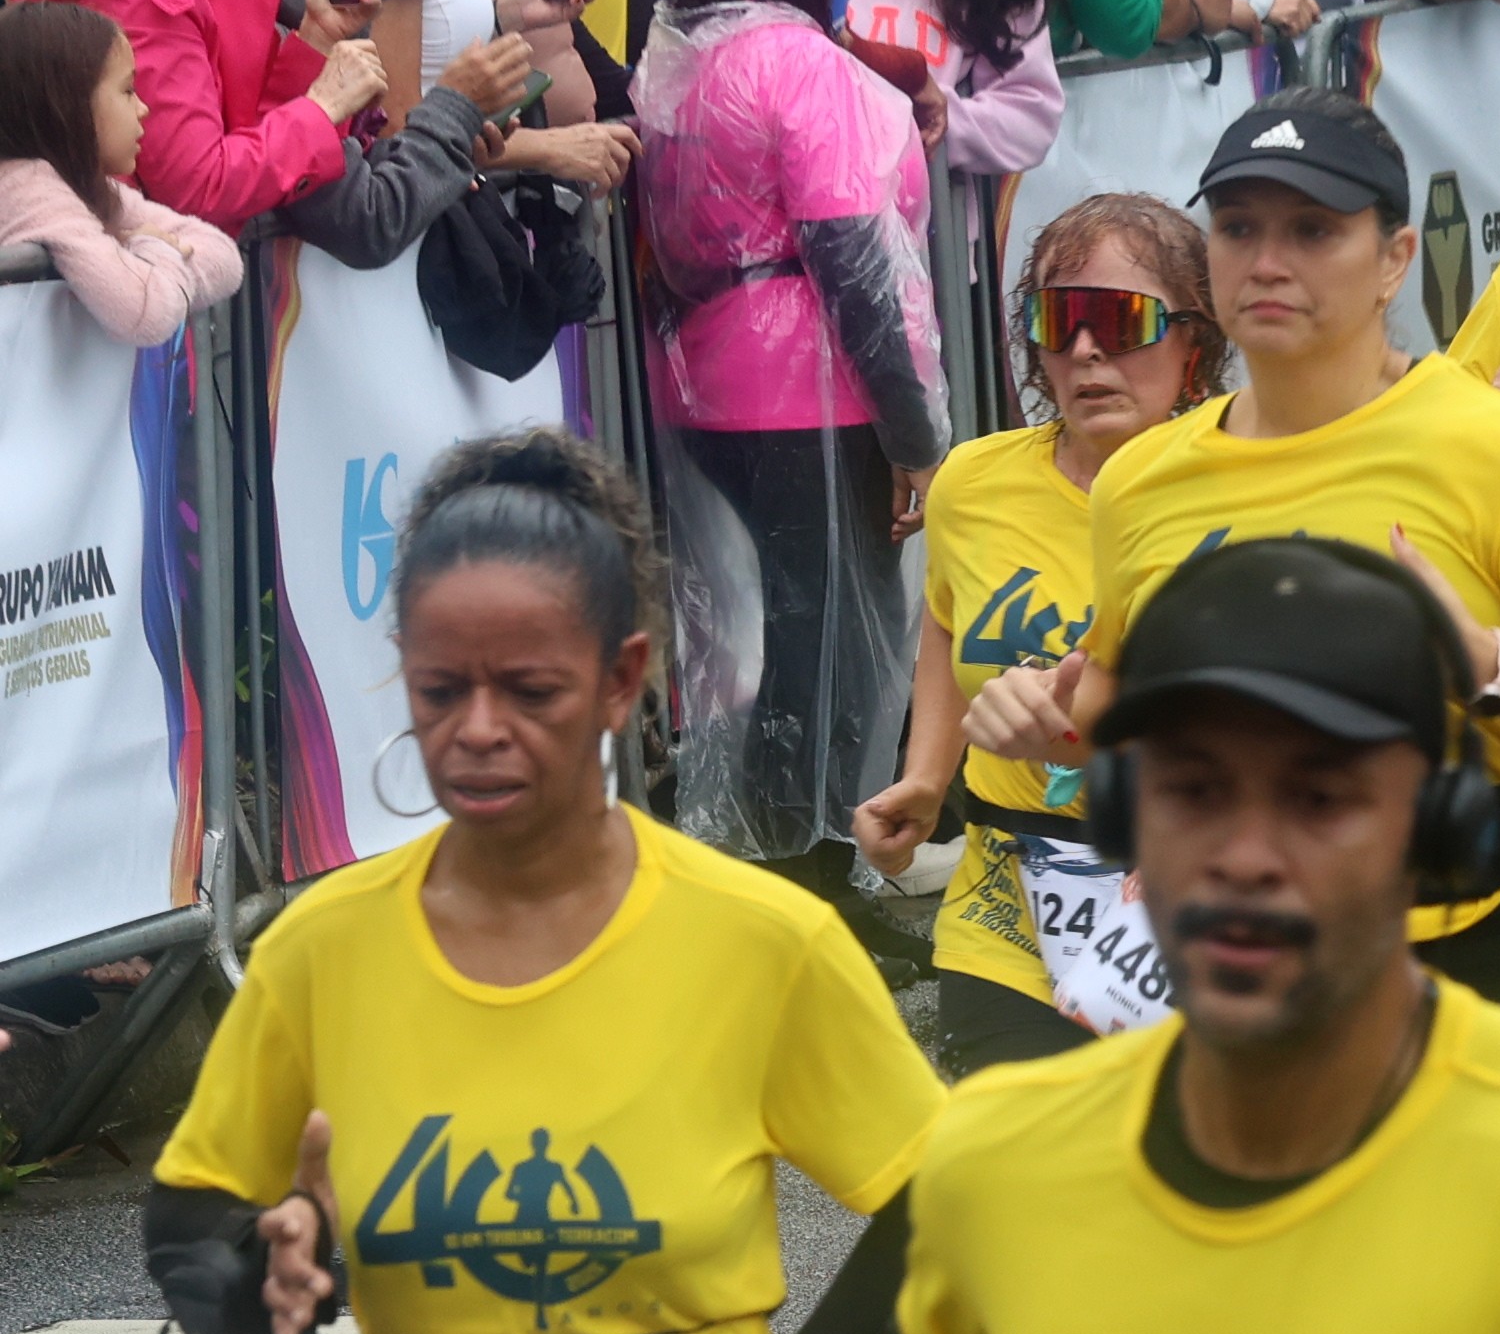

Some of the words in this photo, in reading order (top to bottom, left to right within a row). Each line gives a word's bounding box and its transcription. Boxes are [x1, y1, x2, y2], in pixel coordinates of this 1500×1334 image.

[0, 563, 43, 626] RUPO
[45, 649, 91, 684] GERAIS
[1093, 924, 1177, 1009] 448
